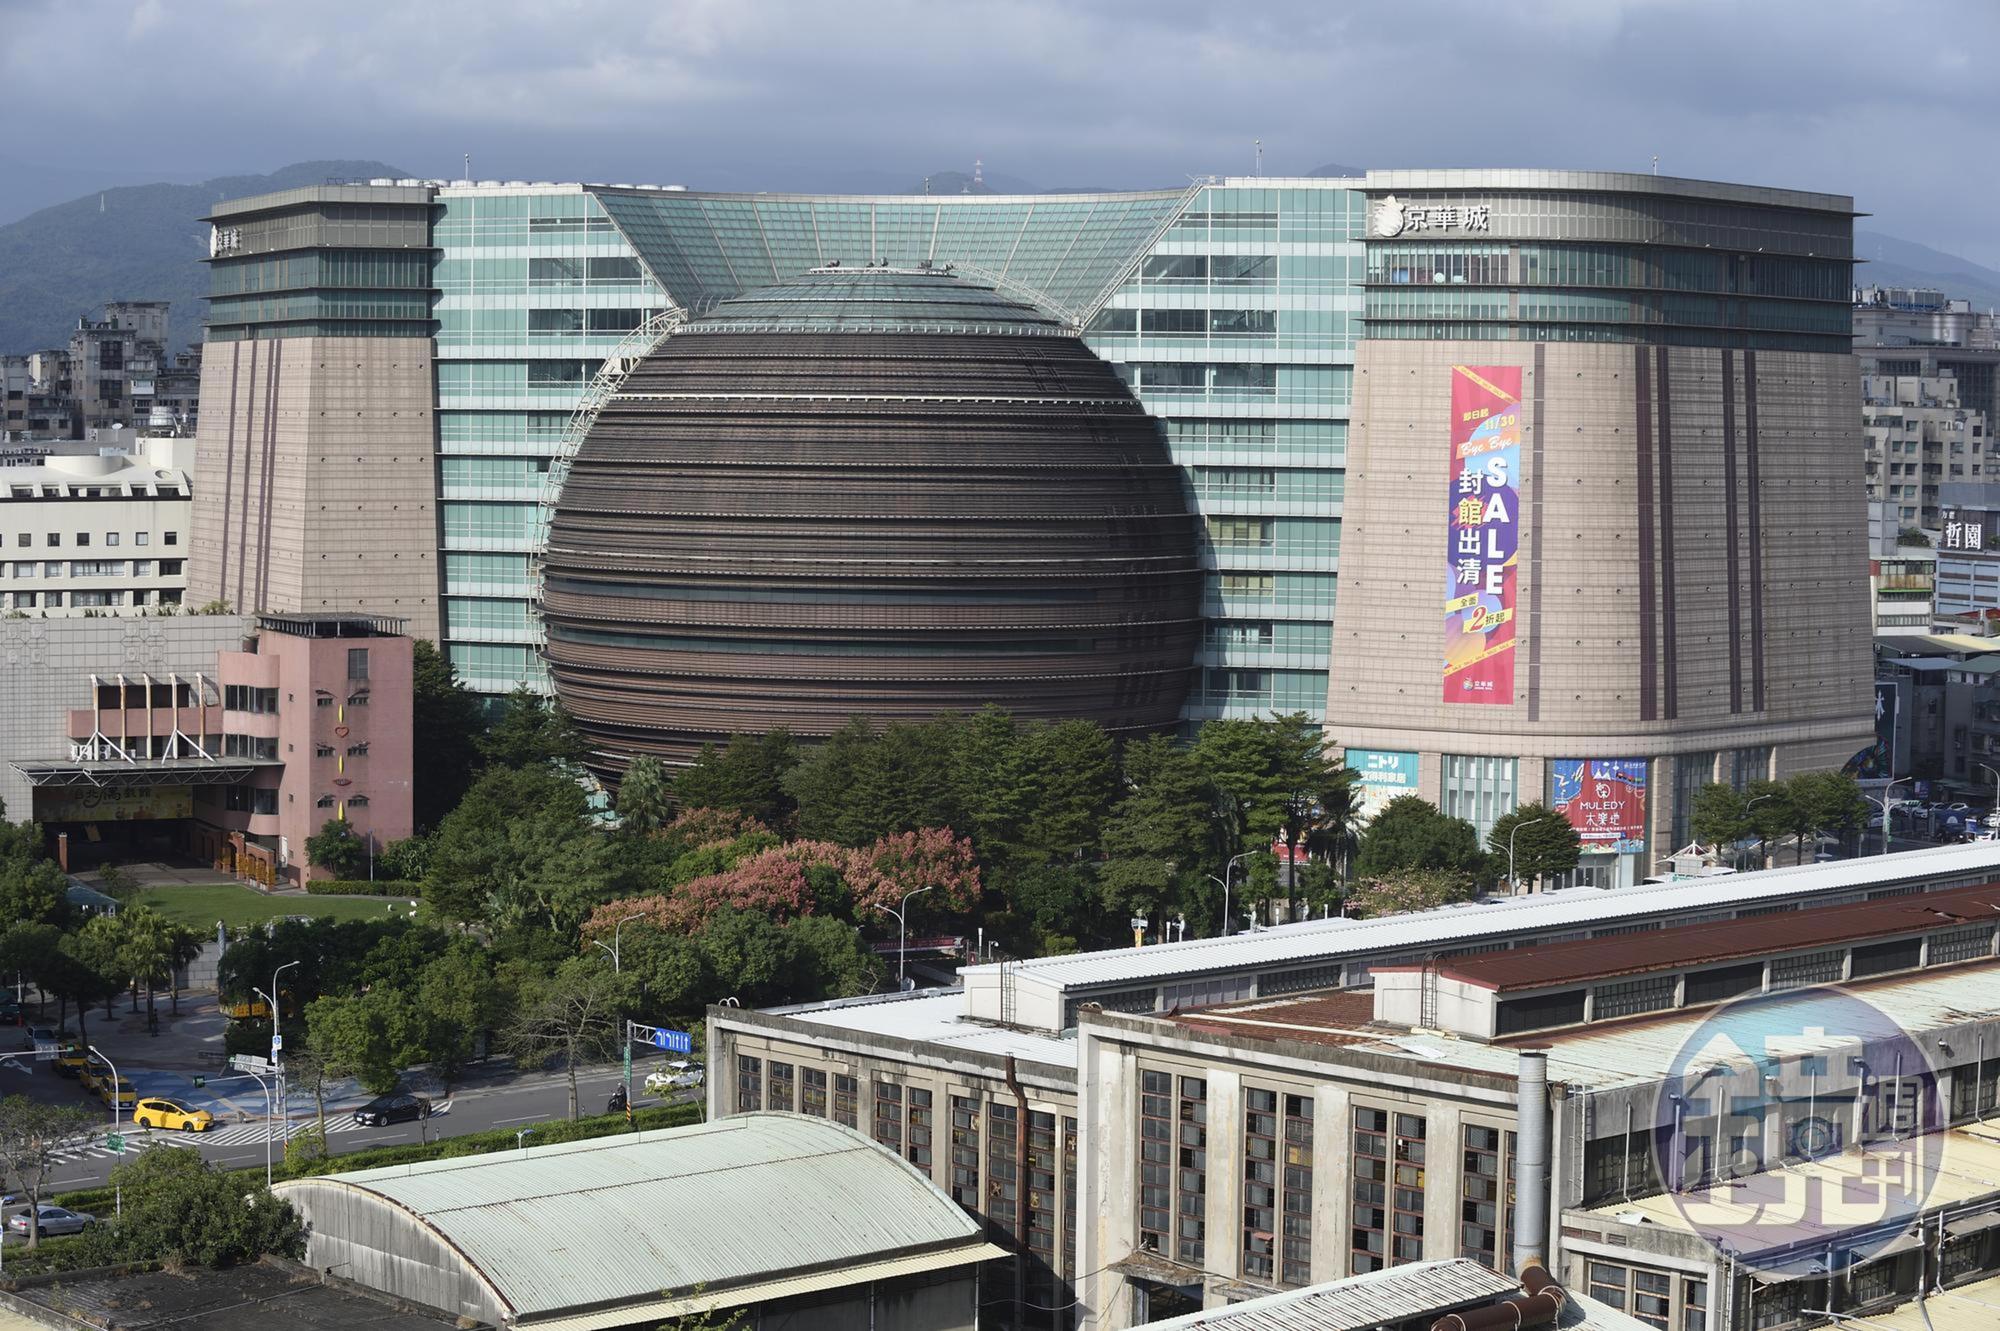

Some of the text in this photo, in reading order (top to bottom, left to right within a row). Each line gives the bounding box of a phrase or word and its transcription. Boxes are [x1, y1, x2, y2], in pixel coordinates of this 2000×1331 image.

[1404, 205, 1489, 231] 京華城
[1485, 414, 1515, 430] 11/30
[1461, 435, 1513, 456] Bye Bye
[1457, 467, 1483, 585] 封館出清
[1483, 456, 1510, 595] SALE
[1945, 522, 1982, 550] 哲園
[1367, 754, 1399, 769] ニトリ
[1580, 801, 1625, 810] MULEDY
